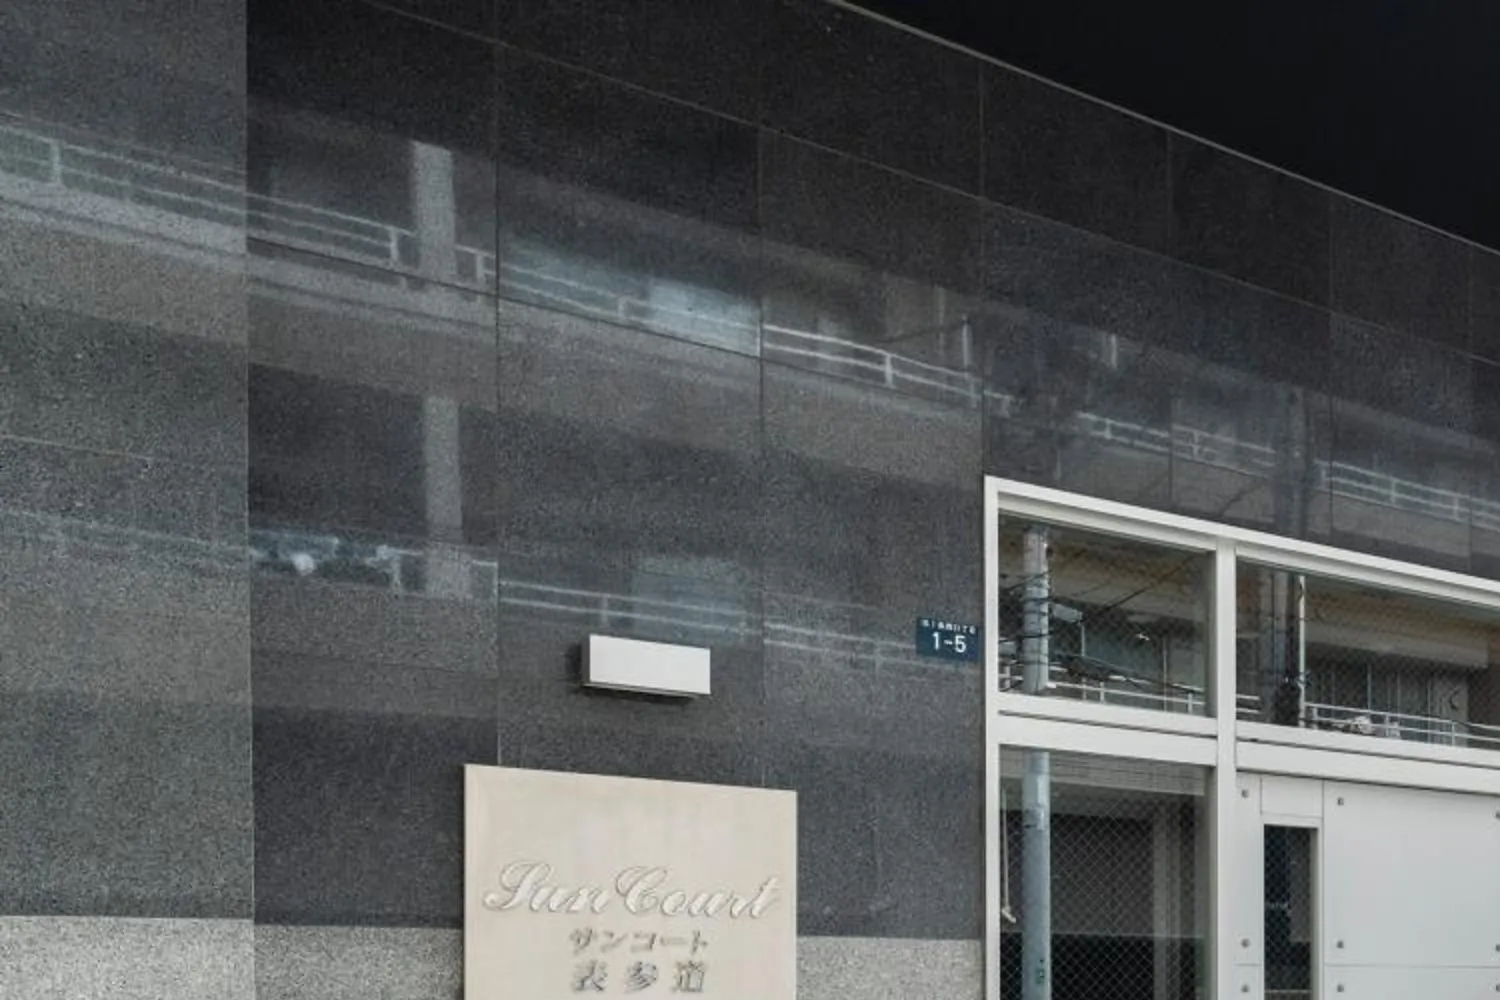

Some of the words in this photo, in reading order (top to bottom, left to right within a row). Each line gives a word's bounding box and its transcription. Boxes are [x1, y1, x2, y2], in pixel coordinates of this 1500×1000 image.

[481, 859, 611, 914] Sun
[614, 865, 780, 921] Court
[568, 926, 710, 956] サンコート
[569, 959, 708, 995] 表参道
